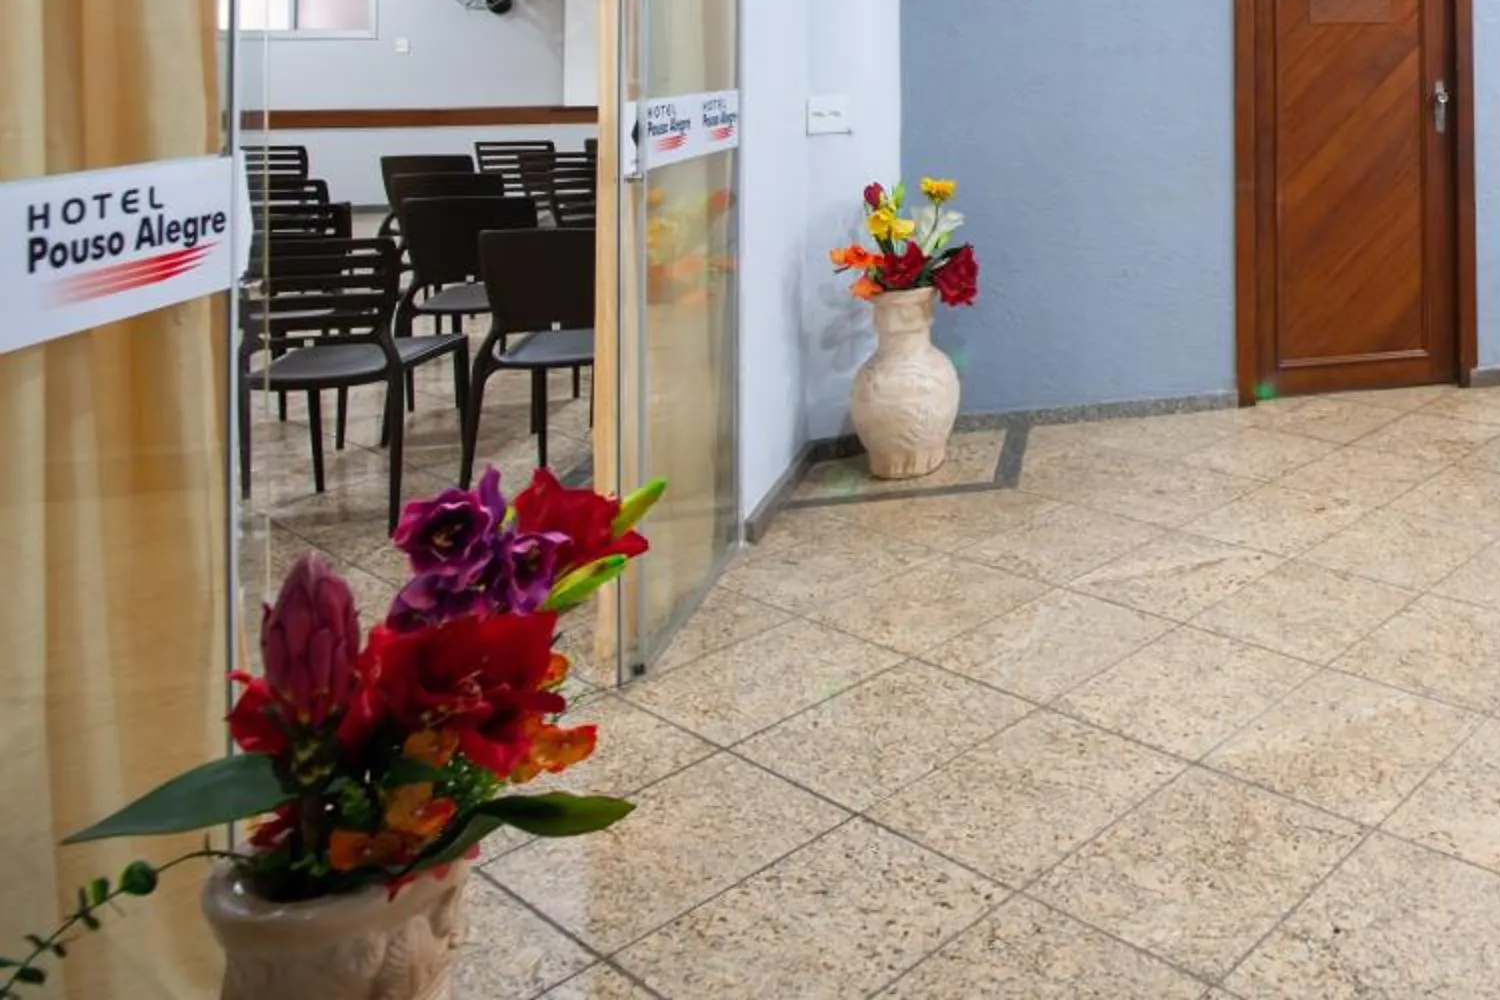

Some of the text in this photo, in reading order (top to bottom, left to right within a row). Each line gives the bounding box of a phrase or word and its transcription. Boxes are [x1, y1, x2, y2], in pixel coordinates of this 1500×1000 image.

[28, 186, 164, 232] HOTEL
[28, 210, 226, 274] Pouso Alegre
